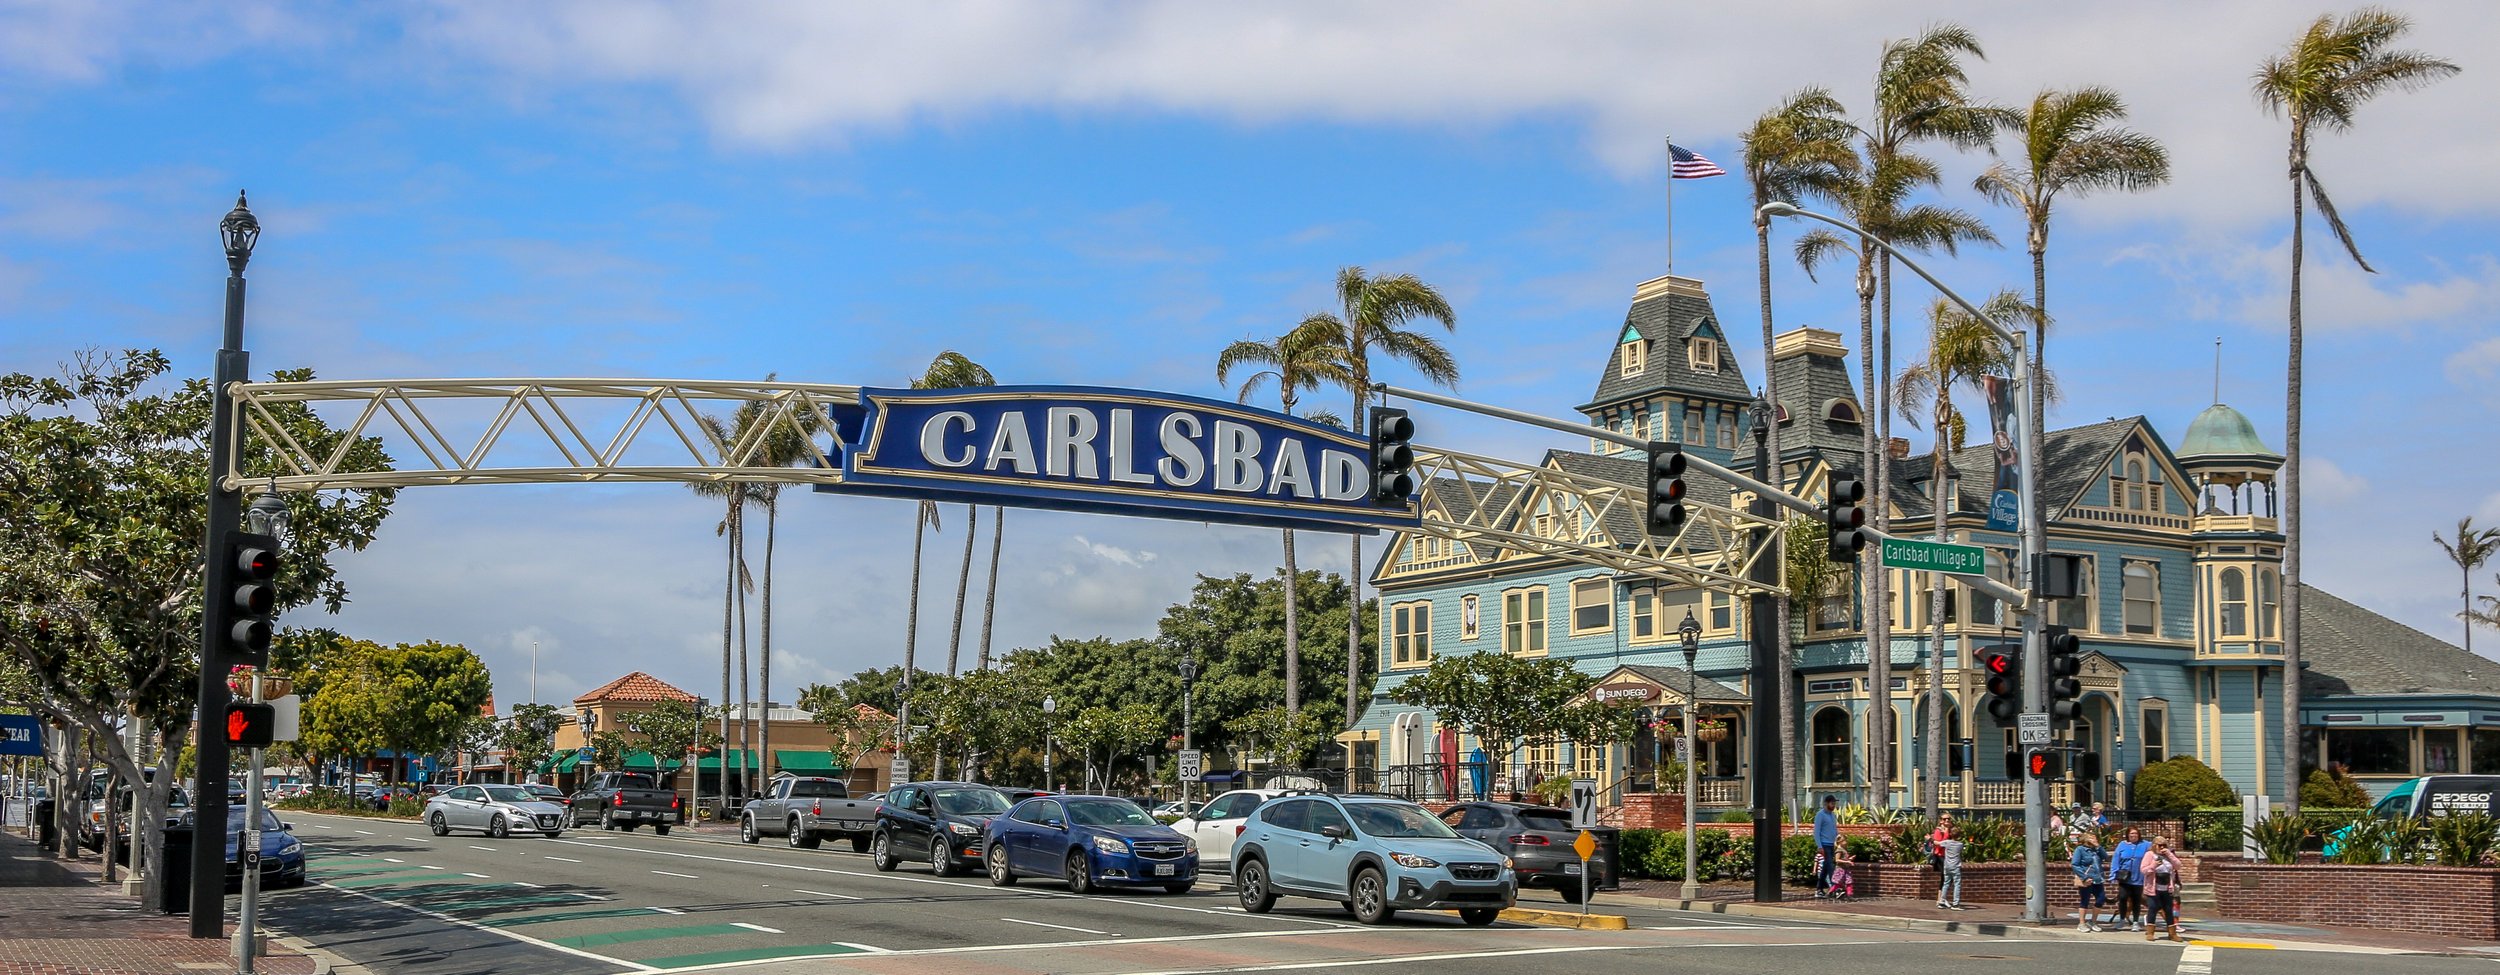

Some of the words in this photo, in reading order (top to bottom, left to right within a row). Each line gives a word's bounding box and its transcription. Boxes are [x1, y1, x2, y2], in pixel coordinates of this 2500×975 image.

[919, 405, 1370, 502] CARLSBAD
[1992, 507, 2017, 526] Village
[1886, 544, 1930, 563] Carlsbad
[1933, 547, 1967, 570] Village
[1970, 552, 1981, 567] Dr
[1605, 690, 1622, 698] SUN
[1623, 688, 1648, 697] DIEGO
[2022, 730, 2037, 742] OK
[1181, 766, 1198, 777] 30
[2433, 793, 2490, 802] PEDEGO
